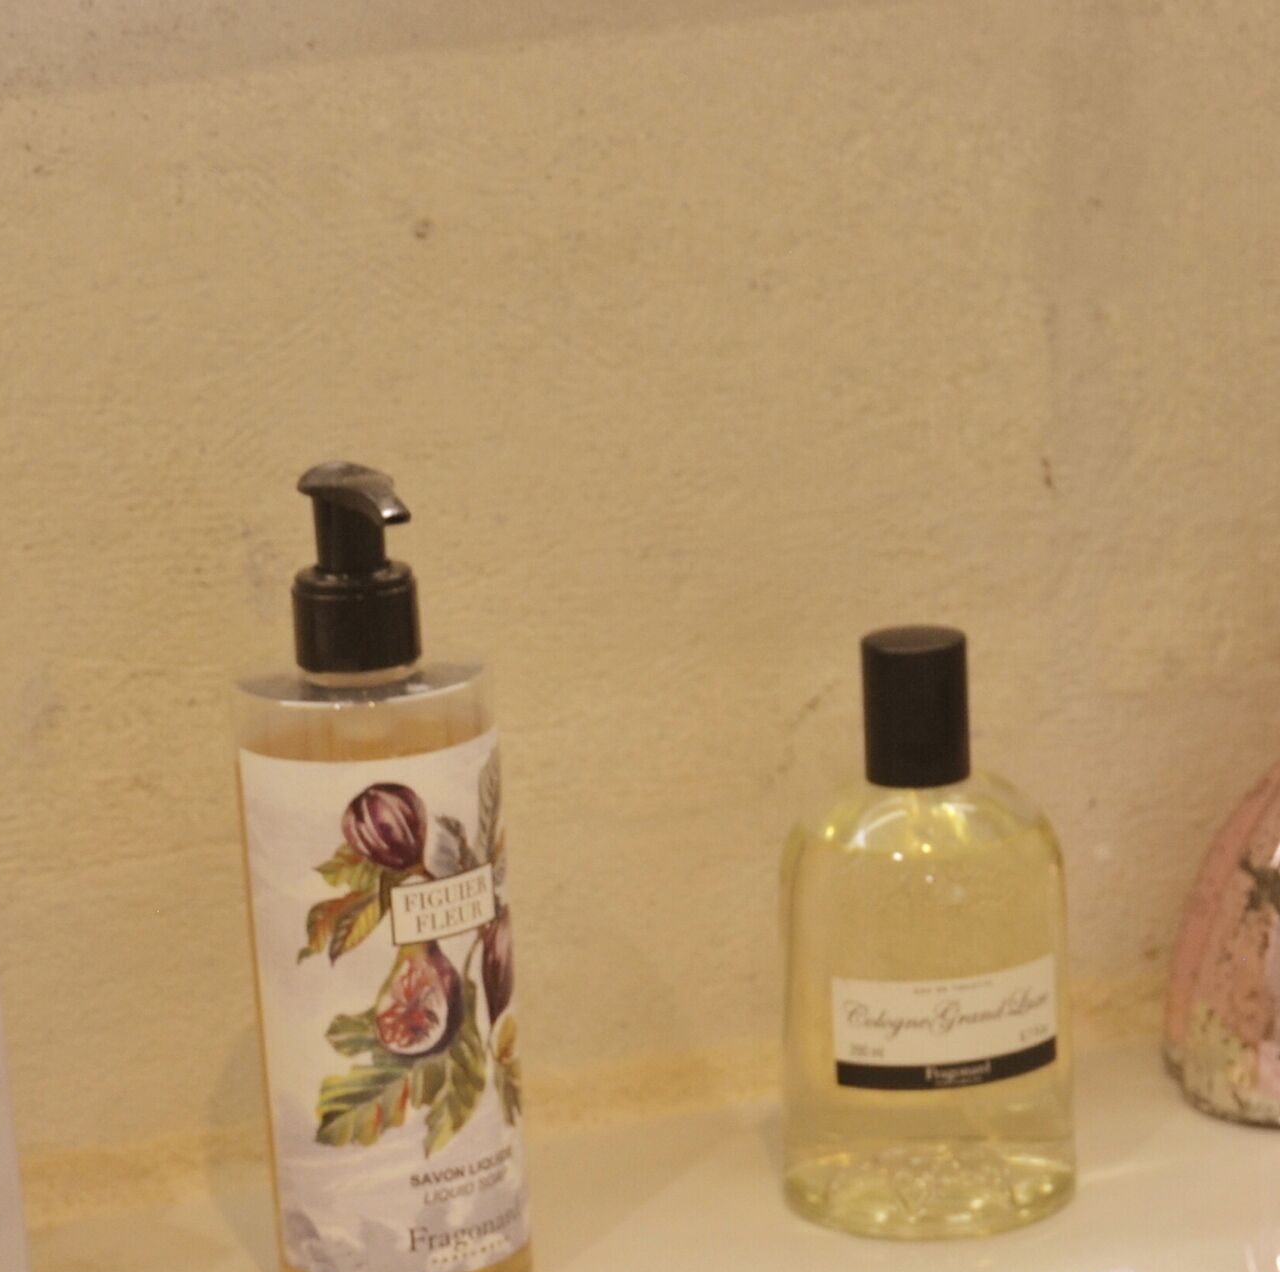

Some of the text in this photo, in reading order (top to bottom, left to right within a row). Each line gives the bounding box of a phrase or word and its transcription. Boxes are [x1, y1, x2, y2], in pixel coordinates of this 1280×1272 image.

[404, 875, 488, 913] FIGUIER
[416, 900, 483, 934] FLEUR
[409, 1167, 465, 1188] SAVON
